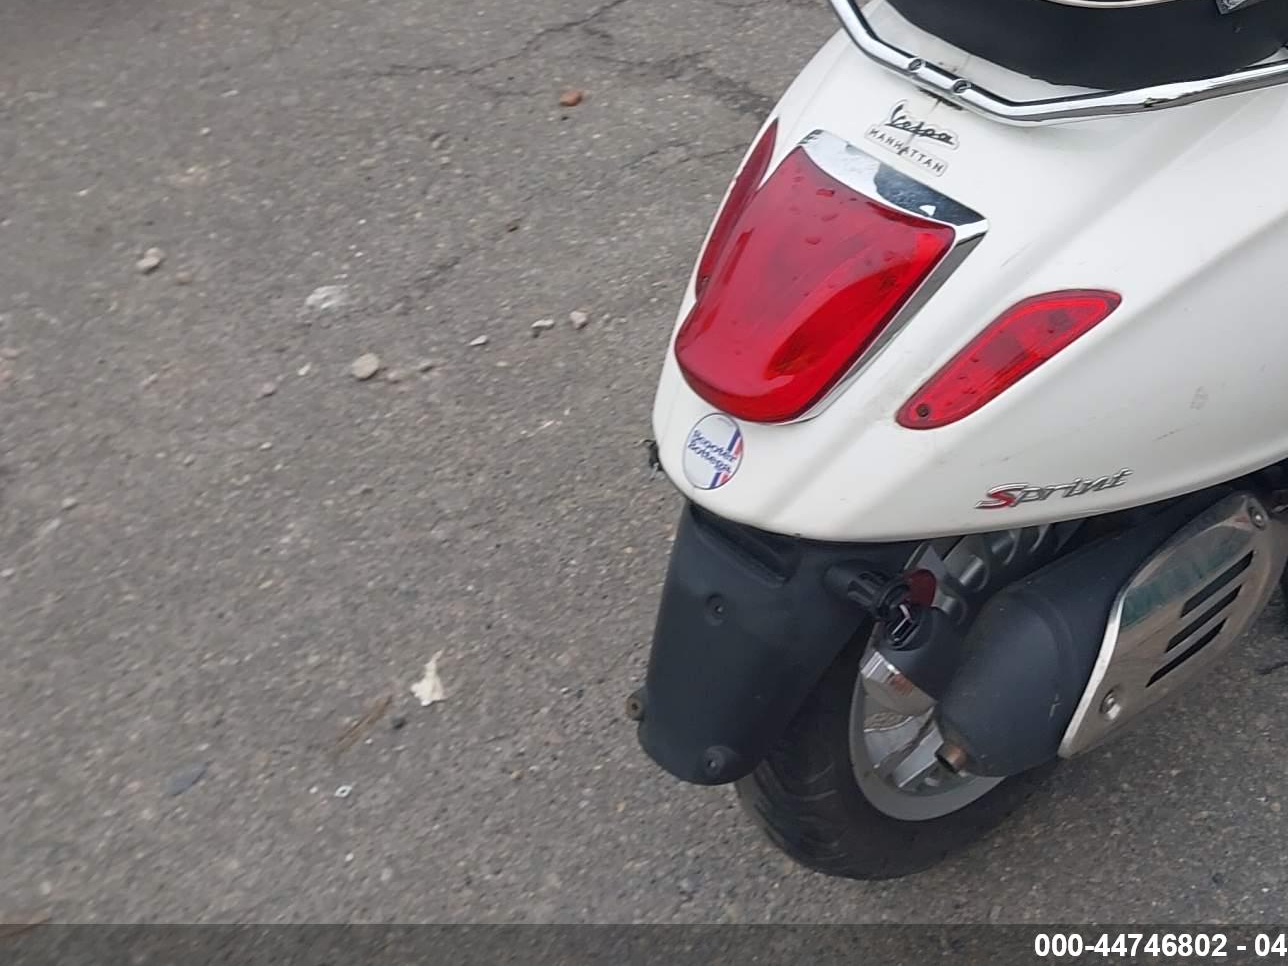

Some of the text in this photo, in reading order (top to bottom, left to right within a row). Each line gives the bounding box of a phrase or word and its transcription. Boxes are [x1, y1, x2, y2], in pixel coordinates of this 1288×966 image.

[884, 104, 955, 145] Vespa
[868, 128, 945, 172] MANHATTAN
[974, 468, 1134, 509] Sprint
